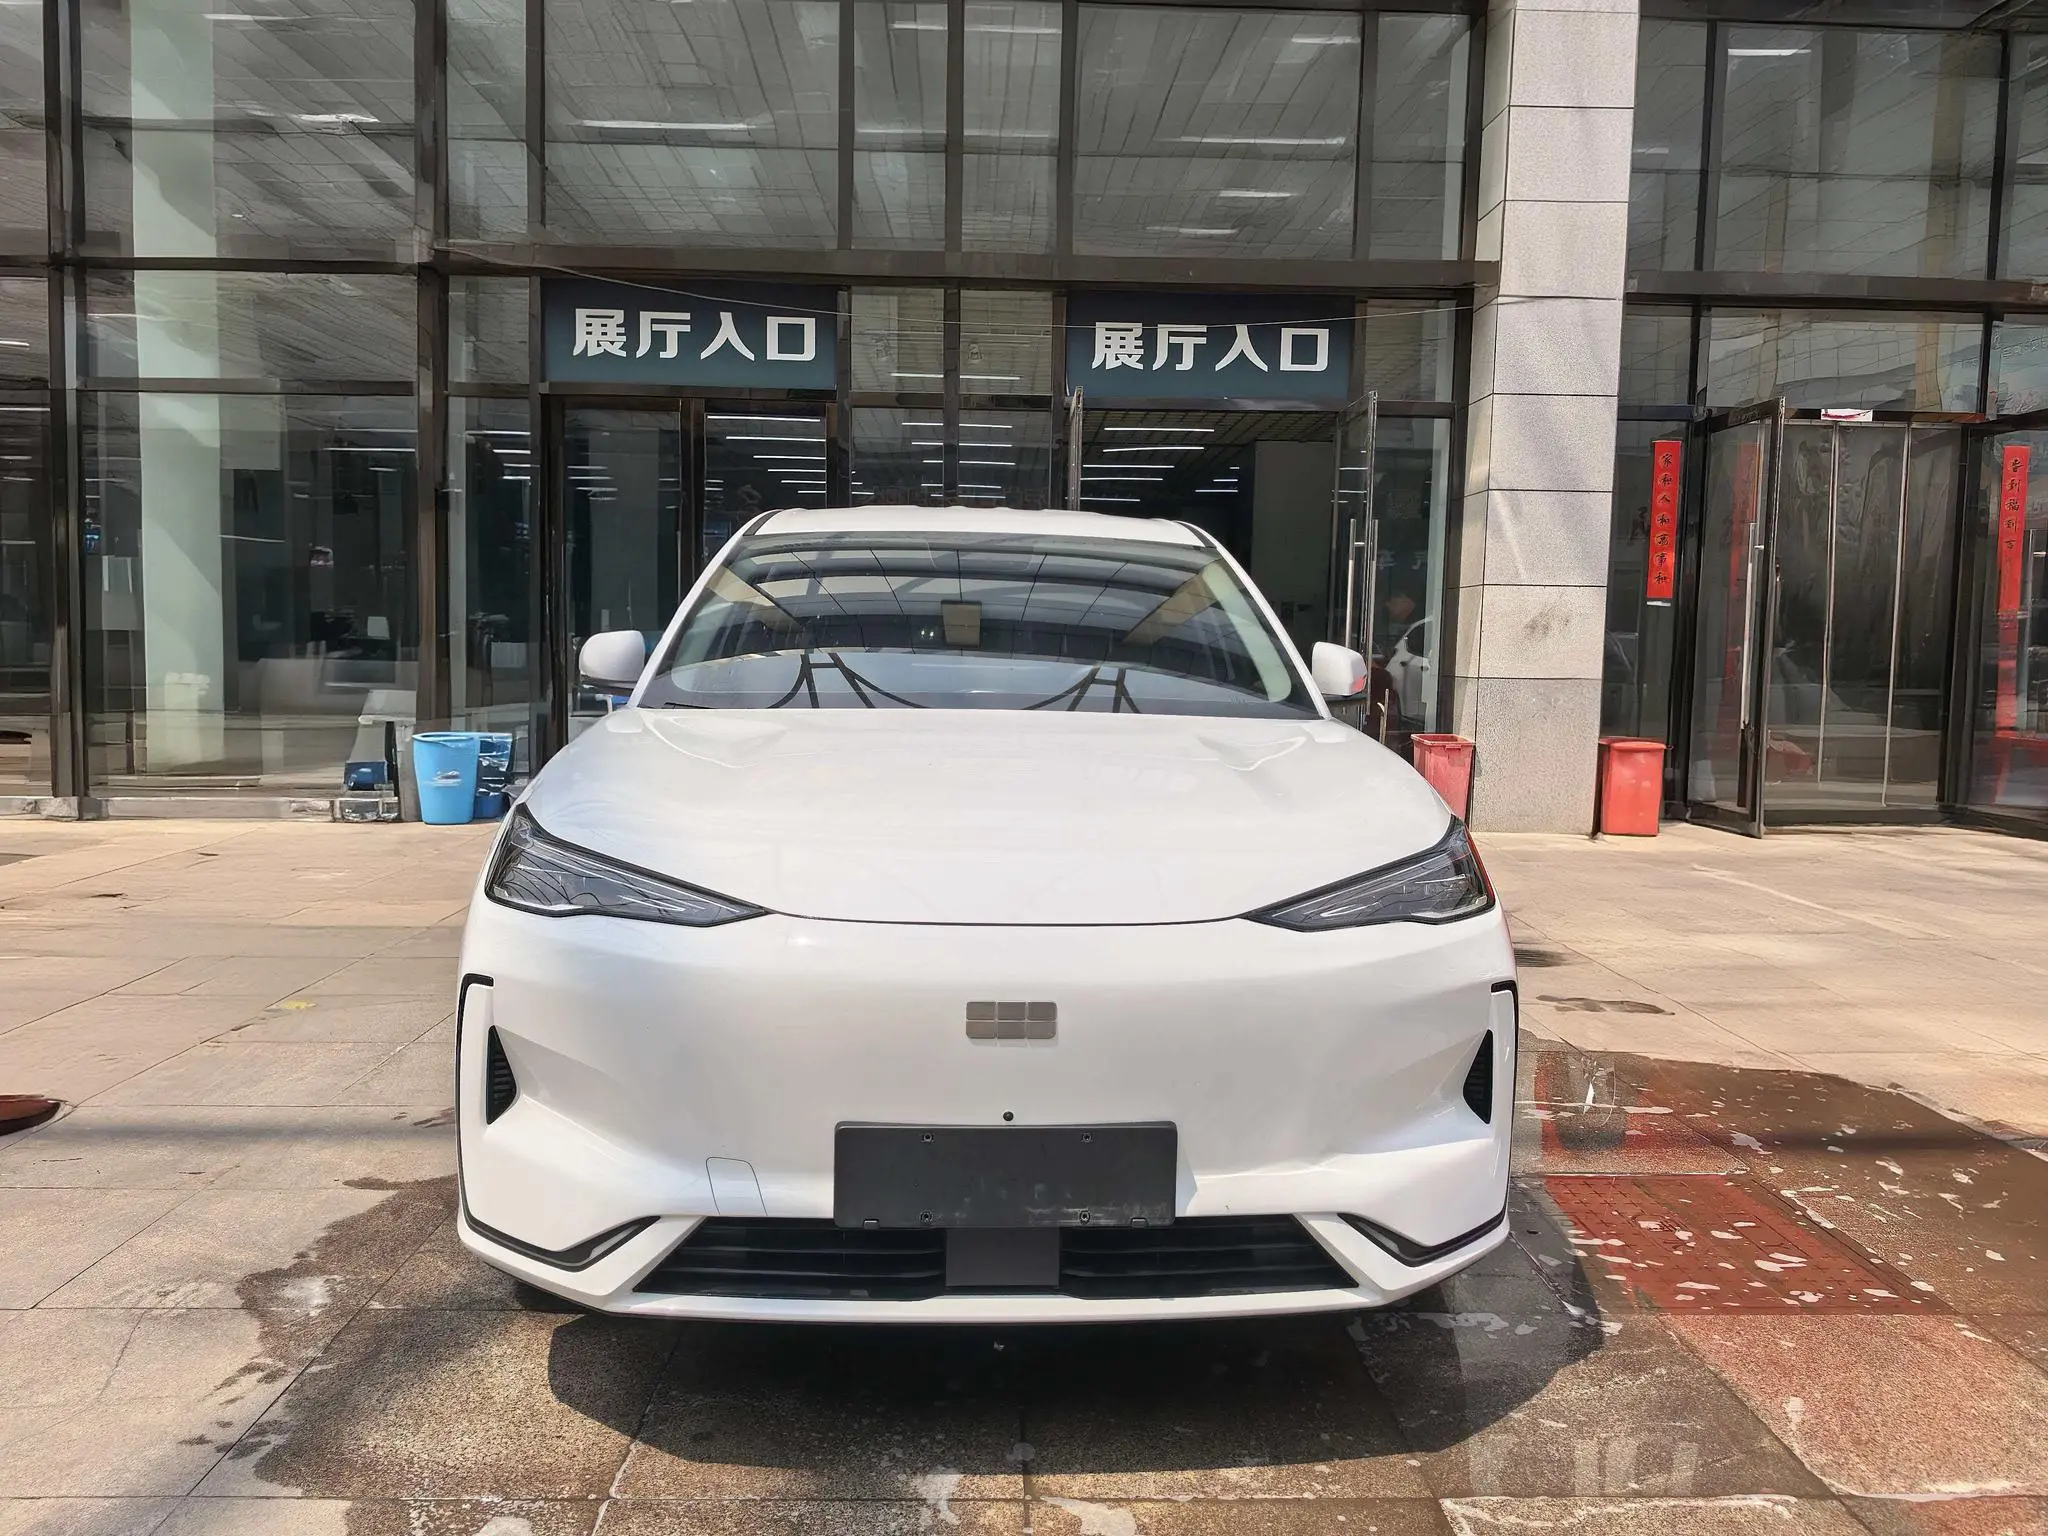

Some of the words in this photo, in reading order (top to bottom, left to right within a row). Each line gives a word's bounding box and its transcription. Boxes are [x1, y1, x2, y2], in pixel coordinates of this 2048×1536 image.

[573, 309, 816, 362] 展厅入口
[1092, 322, 1329, 372] 展厅入口
